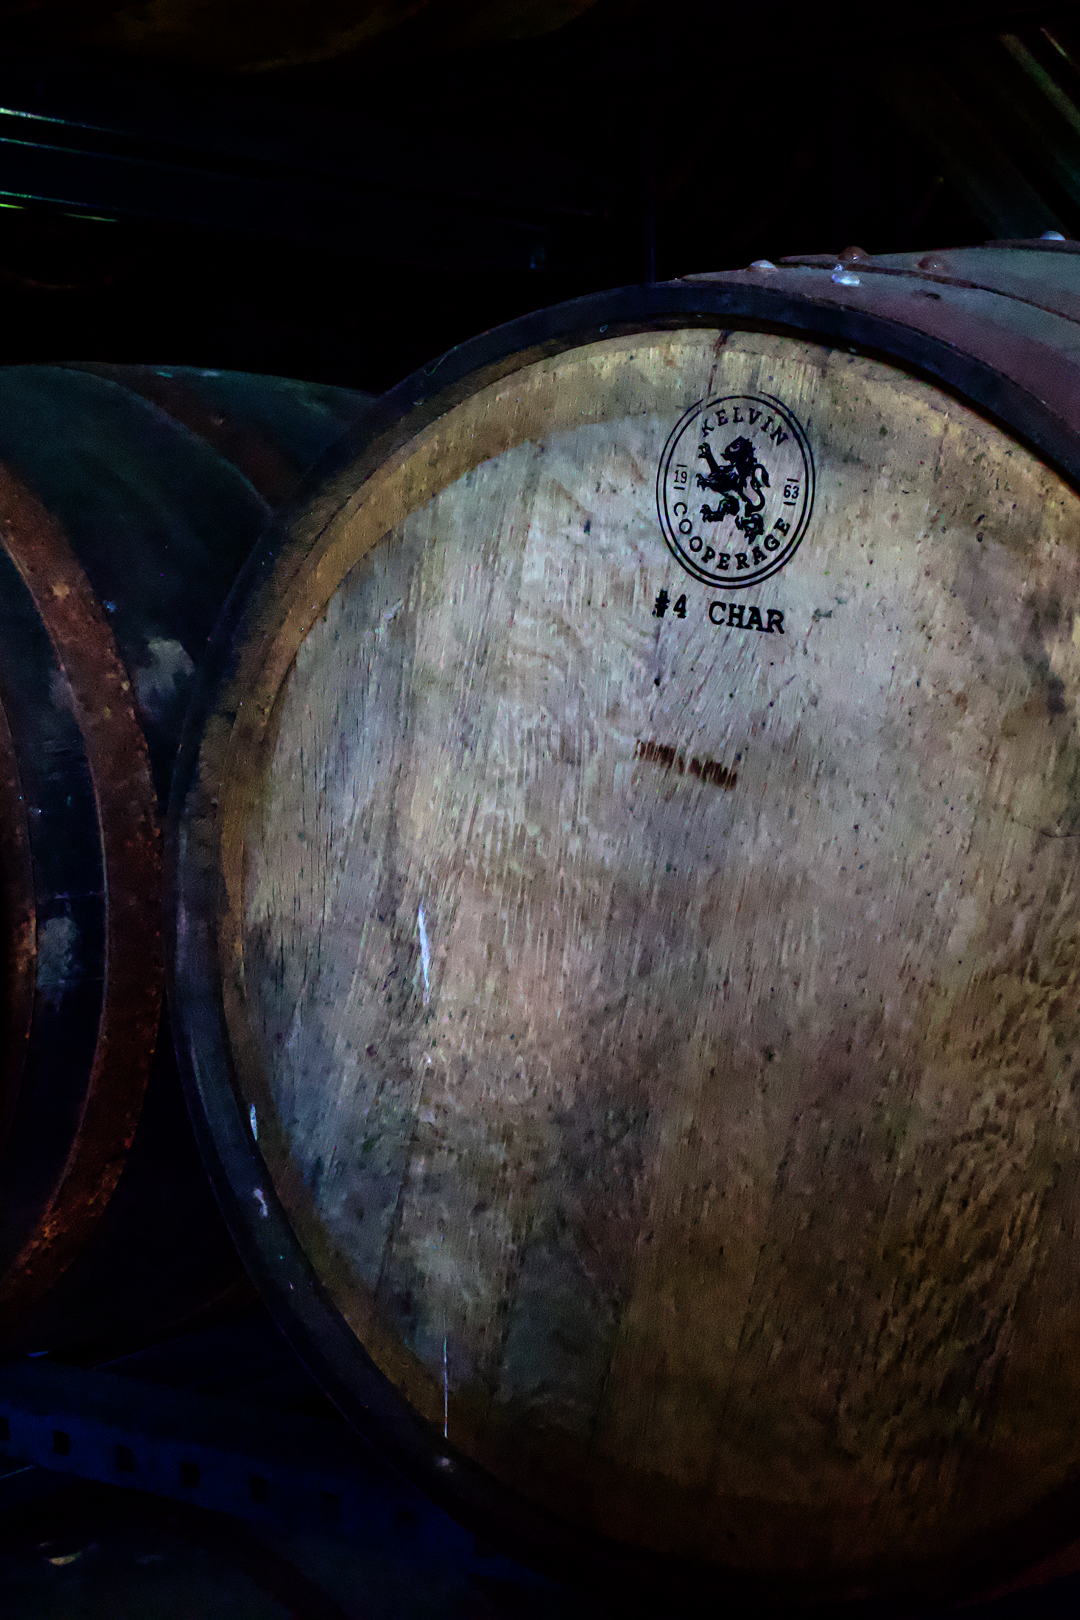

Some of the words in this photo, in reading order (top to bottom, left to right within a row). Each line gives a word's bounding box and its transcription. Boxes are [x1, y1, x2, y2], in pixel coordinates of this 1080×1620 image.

[702, 407, 788, 446] KELVIN
[674, 470, 687, 484] 19
[784, 485, 799, 499] 63
[673, 502, 790, 570] COOPERAGE
[652, 589, 687, 618] #4
[708, 601, 785, 634] CHAR
